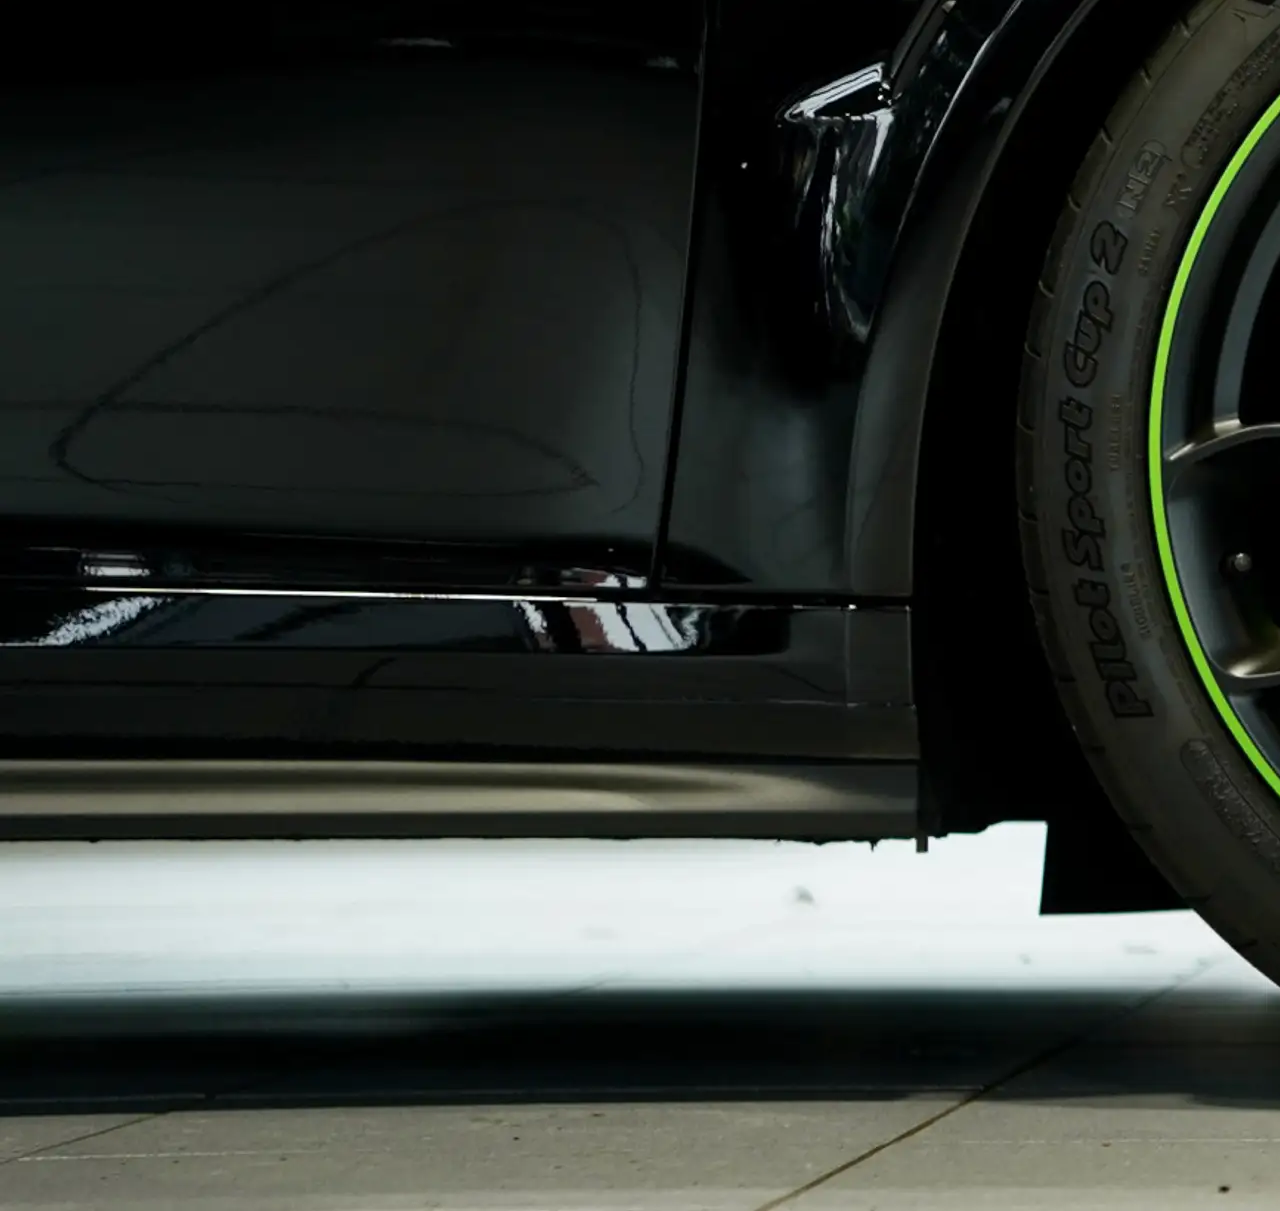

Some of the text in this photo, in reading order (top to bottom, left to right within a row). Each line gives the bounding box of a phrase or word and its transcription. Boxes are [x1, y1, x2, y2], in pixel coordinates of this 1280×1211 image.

[1089, 219, 1129, 275] 2
[1063, 279, 1115, 388] Cup
[1059, 396, 1106, 572] Sport
[1073, 578, 1153, 718] Pilot
